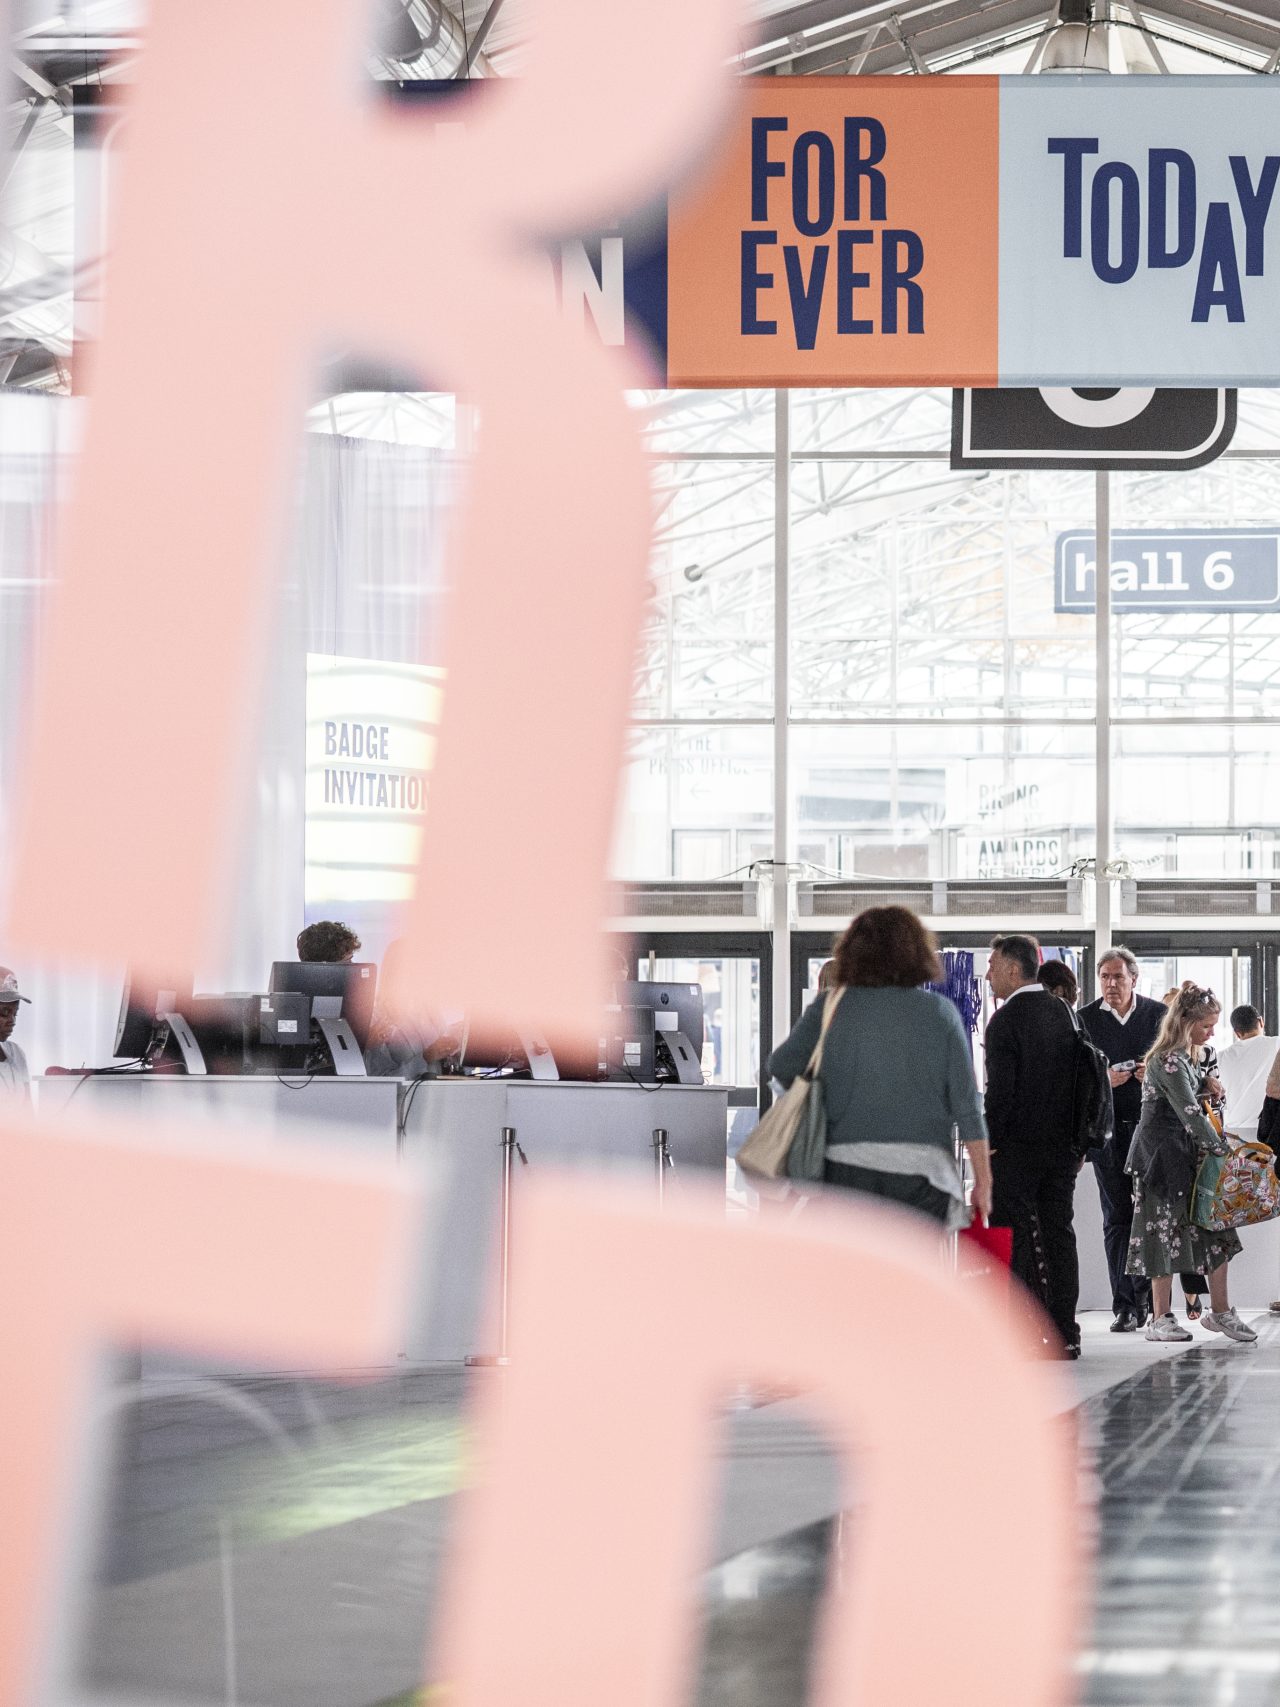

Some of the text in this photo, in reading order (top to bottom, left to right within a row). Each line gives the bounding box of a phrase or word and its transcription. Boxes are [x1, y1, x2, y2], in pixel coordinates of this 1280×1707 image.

[751, 116, 888, 237] FOR
[740, 229, 926, 351] EVER
[1074, 551, 1235, 592] hall 6
[324, 721, 390, 761] BADGE
